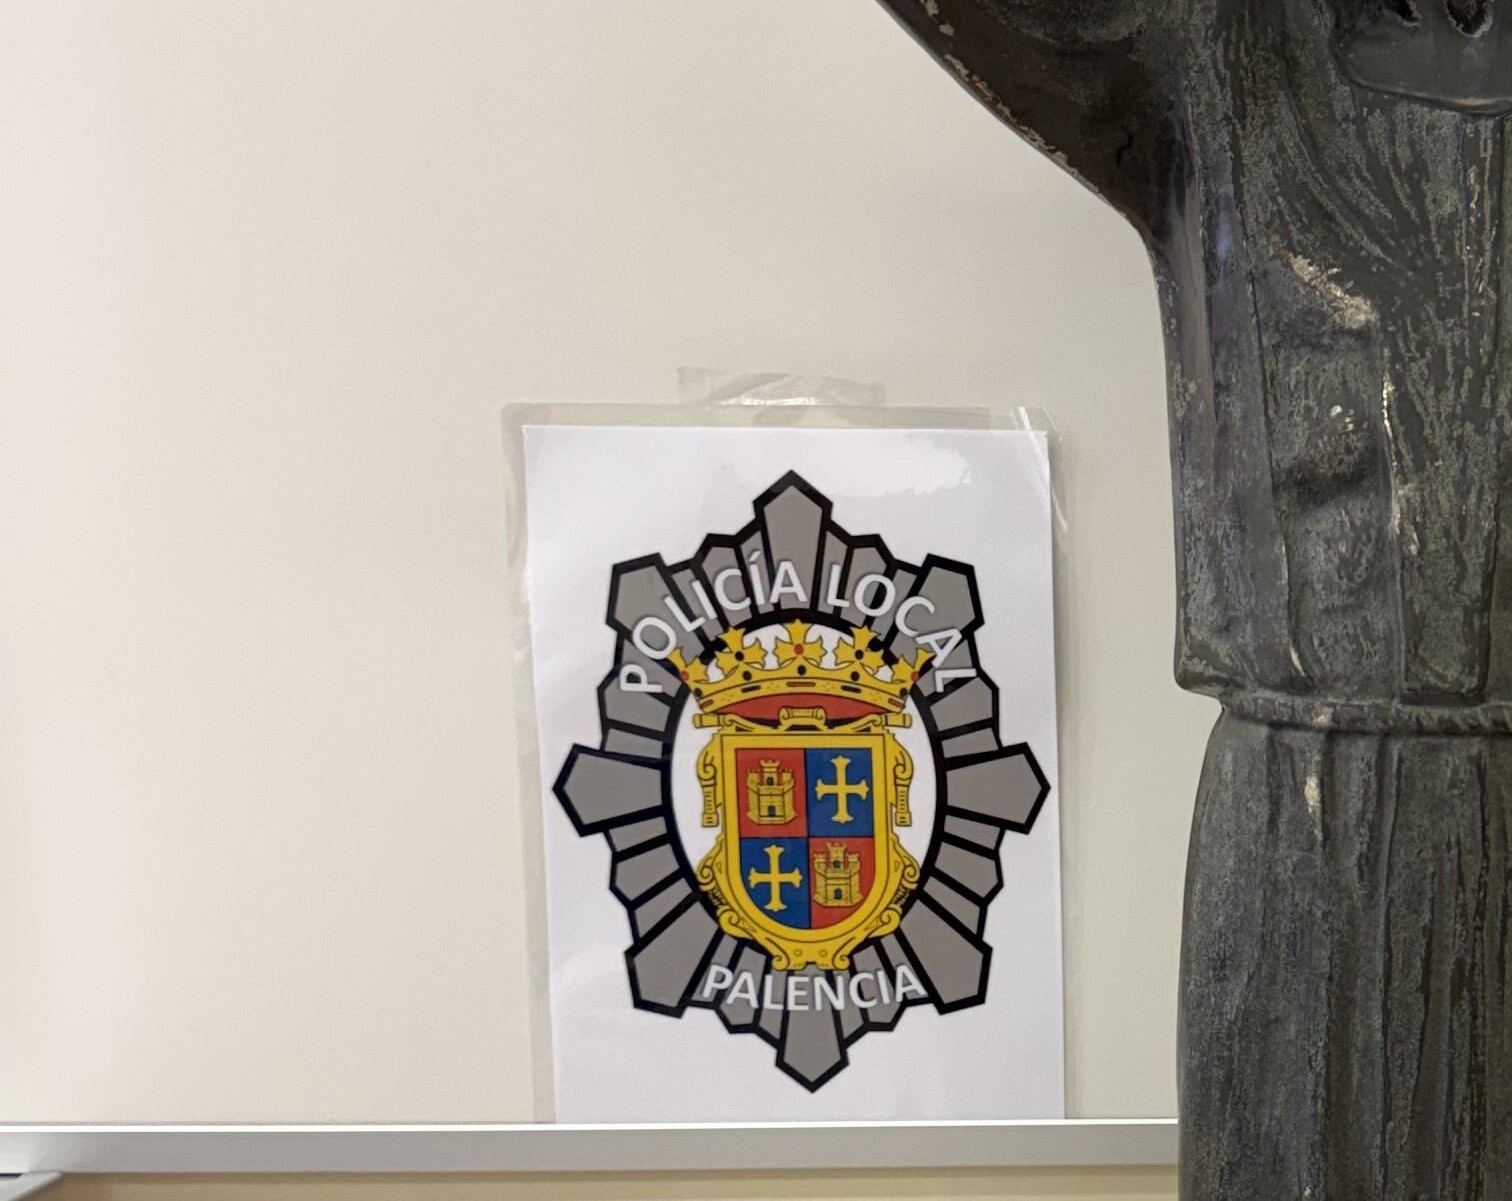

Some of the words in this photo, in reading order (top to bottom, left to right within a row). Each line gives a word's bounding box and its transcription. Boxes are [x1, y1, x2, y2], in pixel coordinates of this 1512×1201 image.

[620, 550, 807, 694] POLICÍA
[826, 563, 977, 693] LOCAL
[702, 965, 927, 1012] PALENCIA
